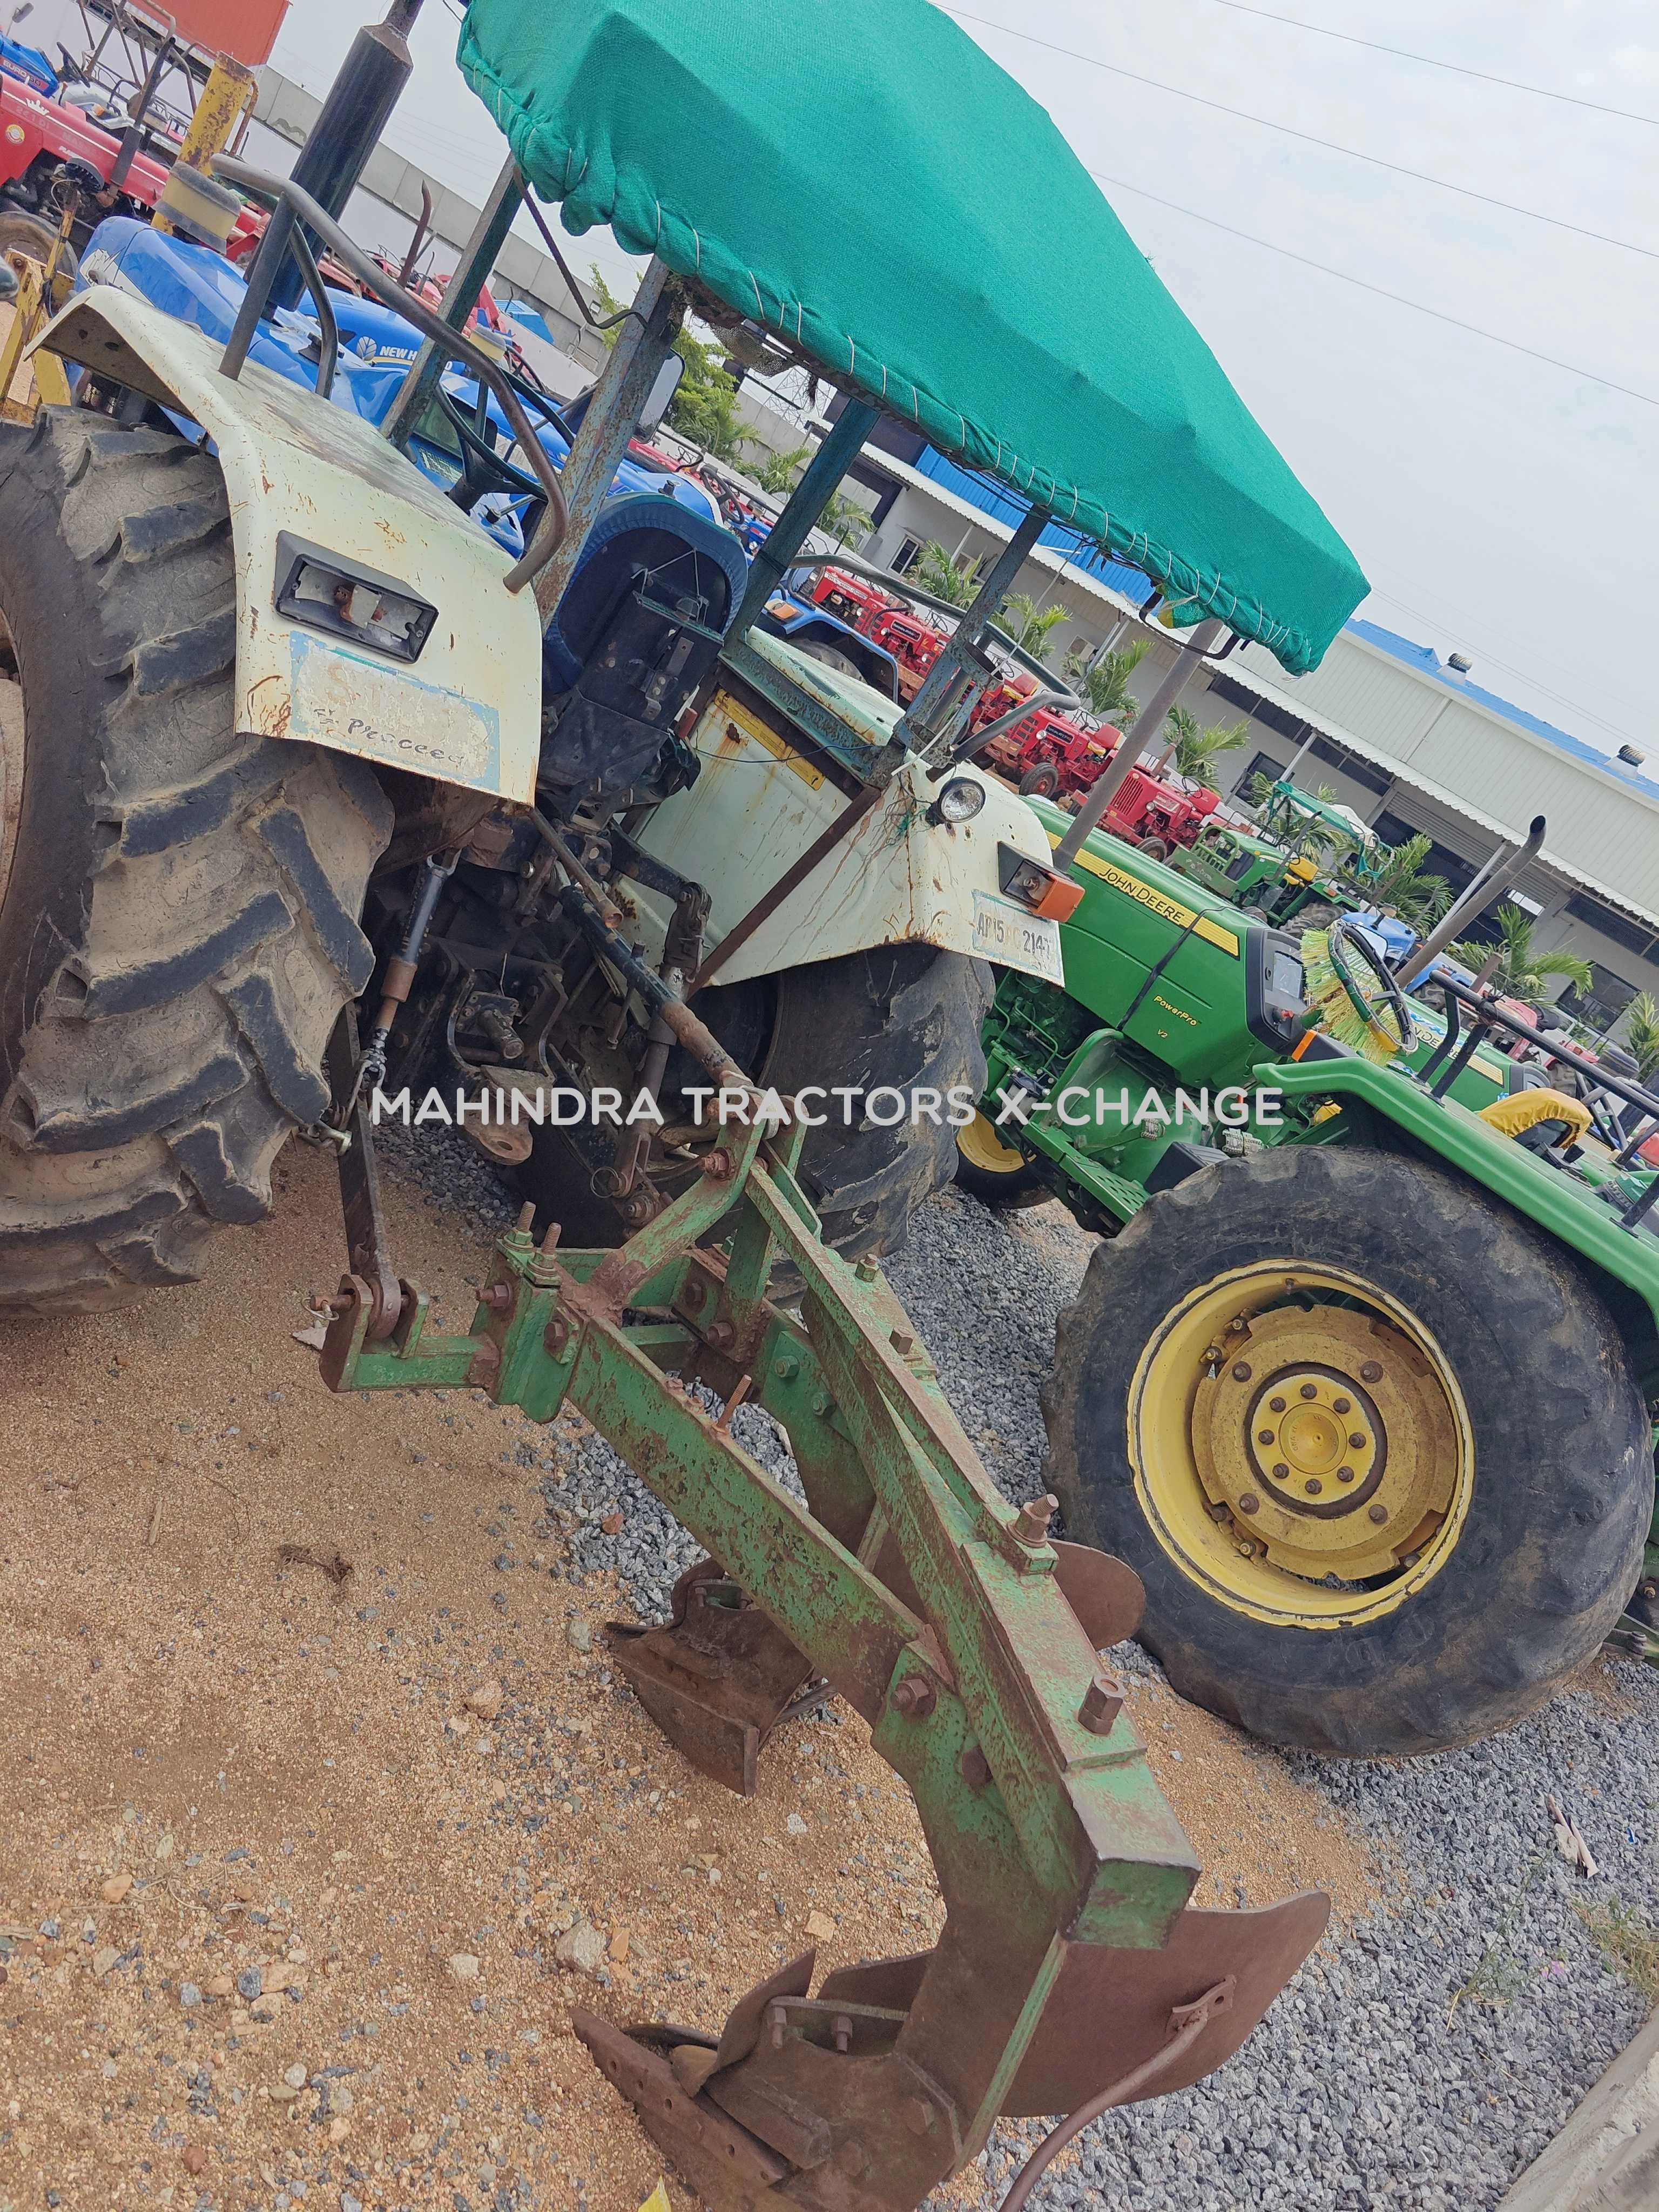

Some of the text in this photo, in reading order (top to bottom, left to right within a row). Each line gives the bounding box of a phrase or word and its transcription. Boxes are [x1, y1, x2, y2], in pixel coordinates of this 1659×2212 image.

[3, 59, 27, 78] EURO
[380, 346, 408, 359] NEW
[1099, 868, 1185, 922] JOHN DEERE
